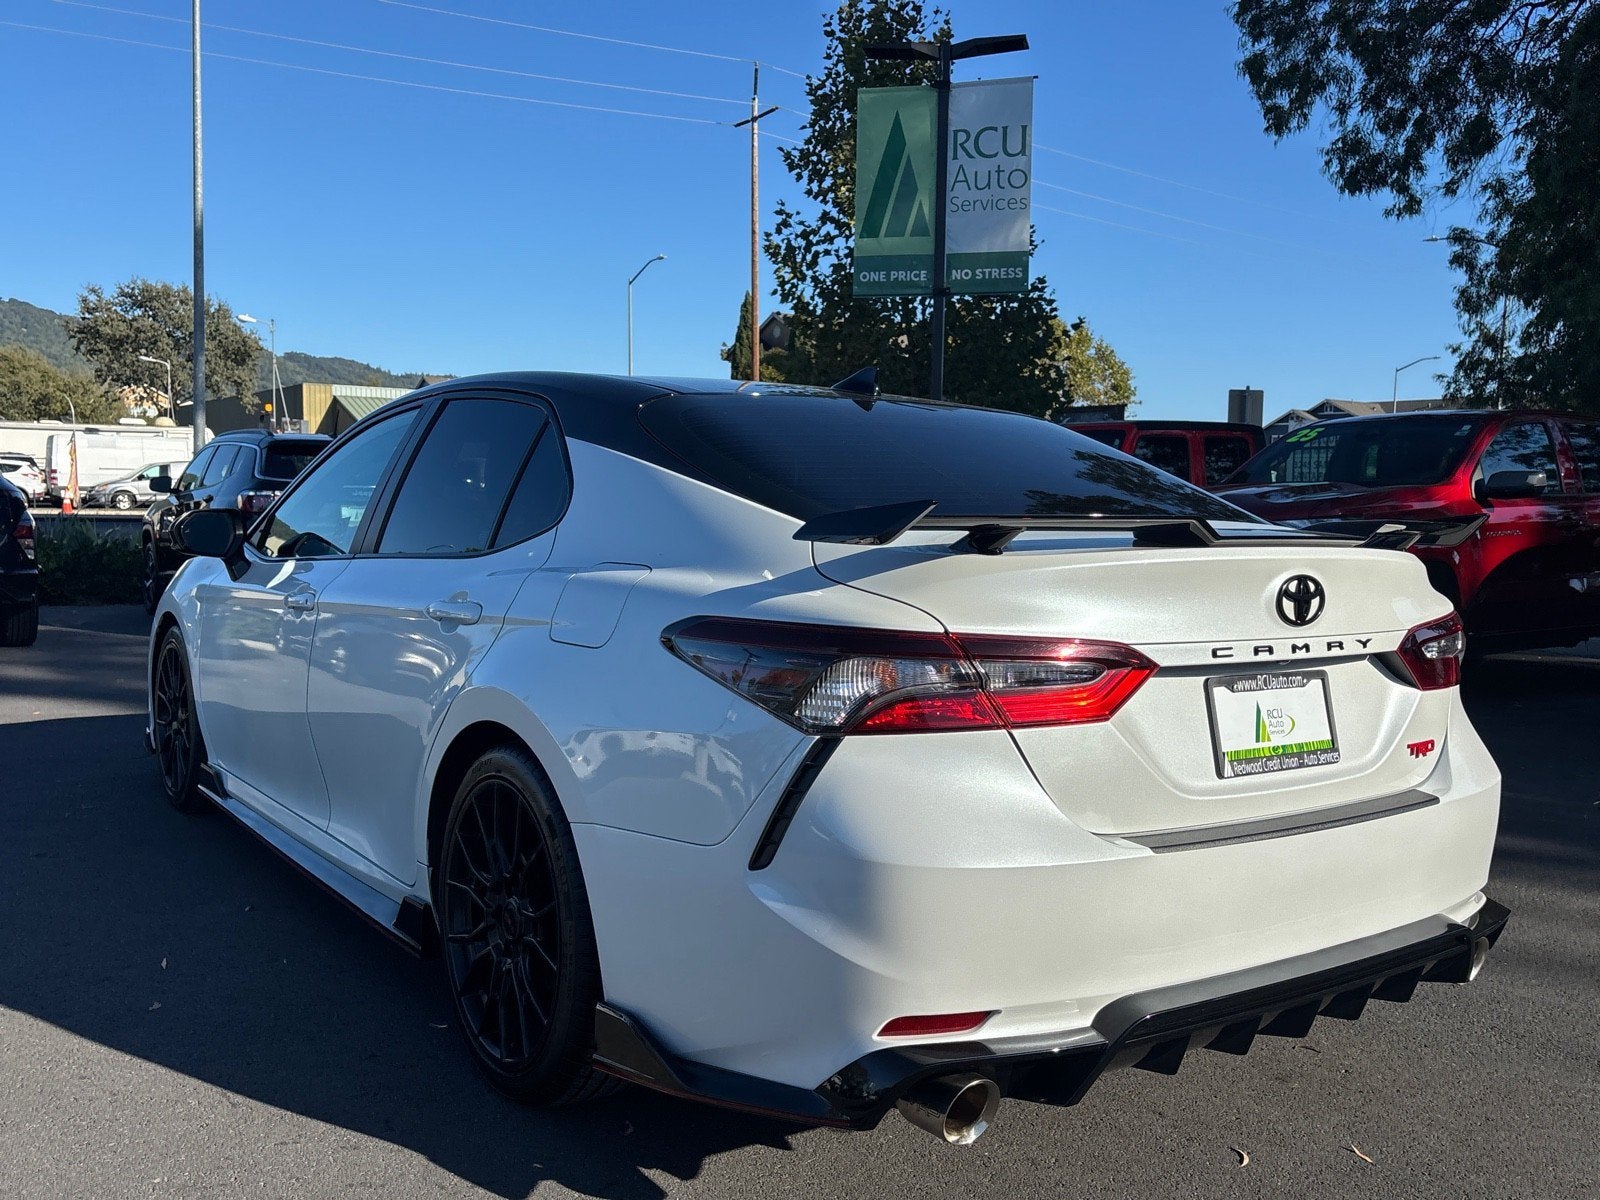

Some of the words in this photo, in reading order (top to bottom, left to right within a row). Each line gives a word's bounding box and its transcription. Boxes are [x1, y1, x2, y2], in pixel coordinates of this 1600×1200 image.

[952, 124, 1029, 161] RCU
[950, 164, 1029, 192] Auto
[950, 195, 1028, 212] Services
[859, 271, 887, 282] ONE
[890, 270, 928, 282] PRICE
[951, 268, 973, 280] NO
[975, 267, 1024, 279] STRESS
[1286, 427, 1326, 443] 25
[1211, 637, 1373, 659] CAMRY
[1266, 708, 1283, 719] RCU
[1268, 720, 1285, 729] Auto
[1407, 738, 1435, 760] TRD
[1234, 760, 1262, 776] Redwood
[1263, 757, 1281, 772] Credit
[1281, 755, 1300, 769] Union
[1304, 753, 1318, 766] Auto
[1318, 750, 1340, 764] Services
